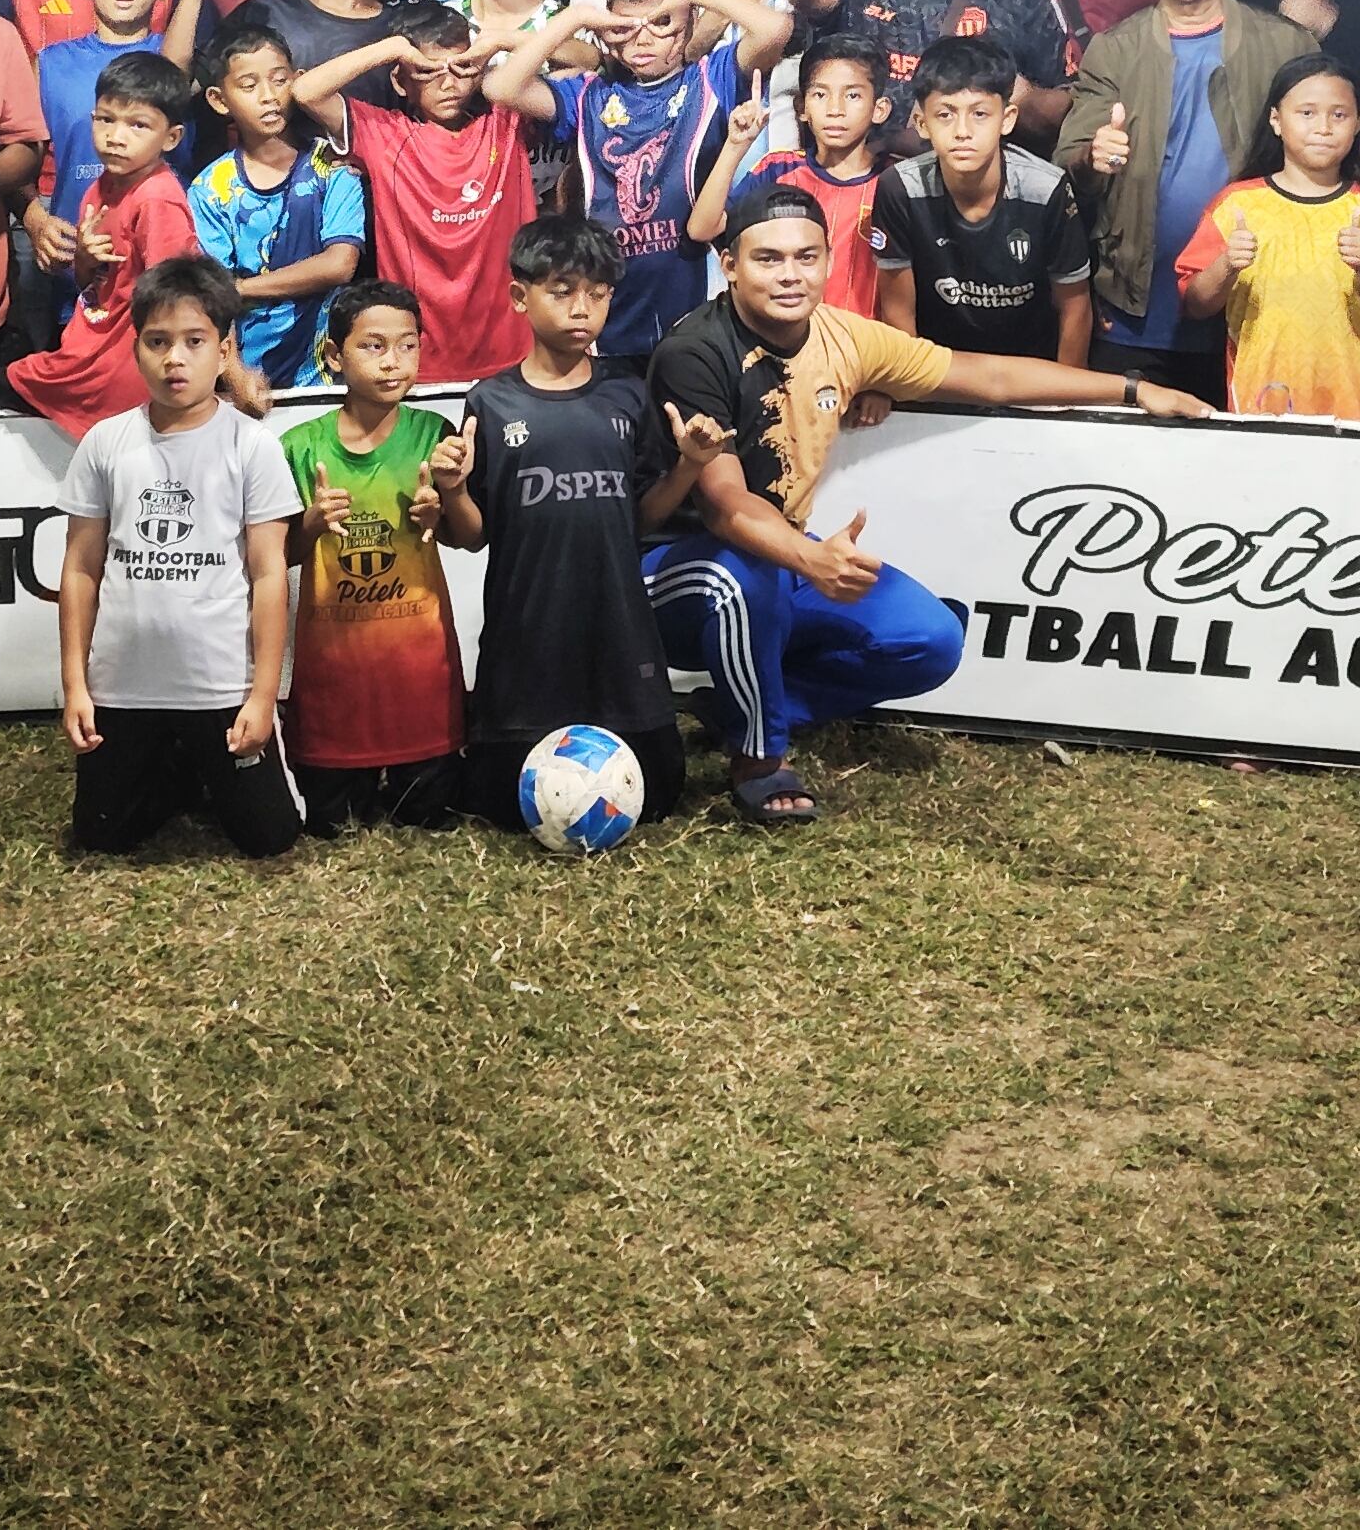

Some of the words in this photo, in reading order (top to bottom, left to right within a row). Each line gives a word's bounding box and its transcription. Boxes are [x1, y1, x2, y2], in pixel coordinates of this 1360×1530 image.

[614, 219, 682, 246] OMEL
[960, 280, 1035, 297] chicken
[516, 466, 627, 507] DSPEX
[126, 566, 201, 581] ACADEMY
[337, 576, 408, 604] Peteh
[942, 597, 1252, 680] TBALL
